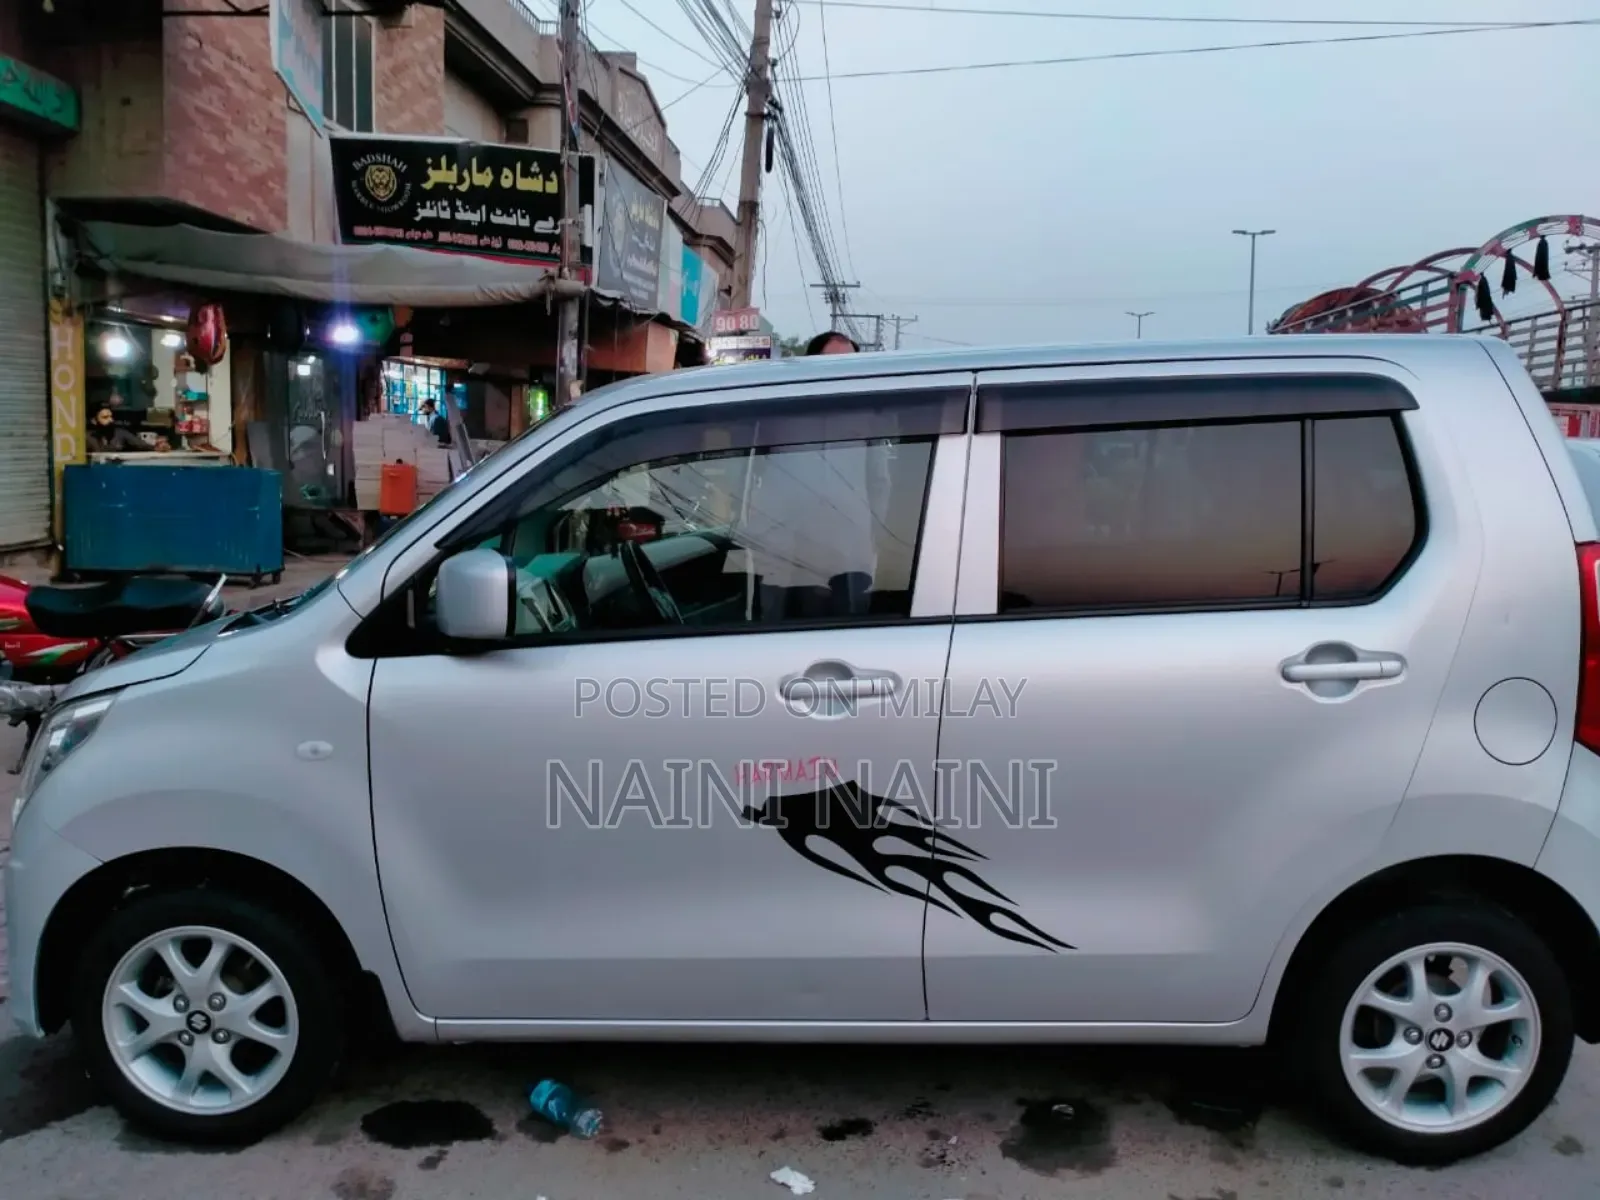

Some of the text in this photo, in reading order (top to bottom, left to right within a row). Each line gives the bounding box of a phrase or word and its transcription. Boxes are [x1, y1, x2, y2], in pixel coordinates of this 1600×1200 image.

[352, 152, 408, 173] BADSHAH
[420, 154, 559, 194] دشاه ماربلز
[51, 322, 77, 461] HOND
